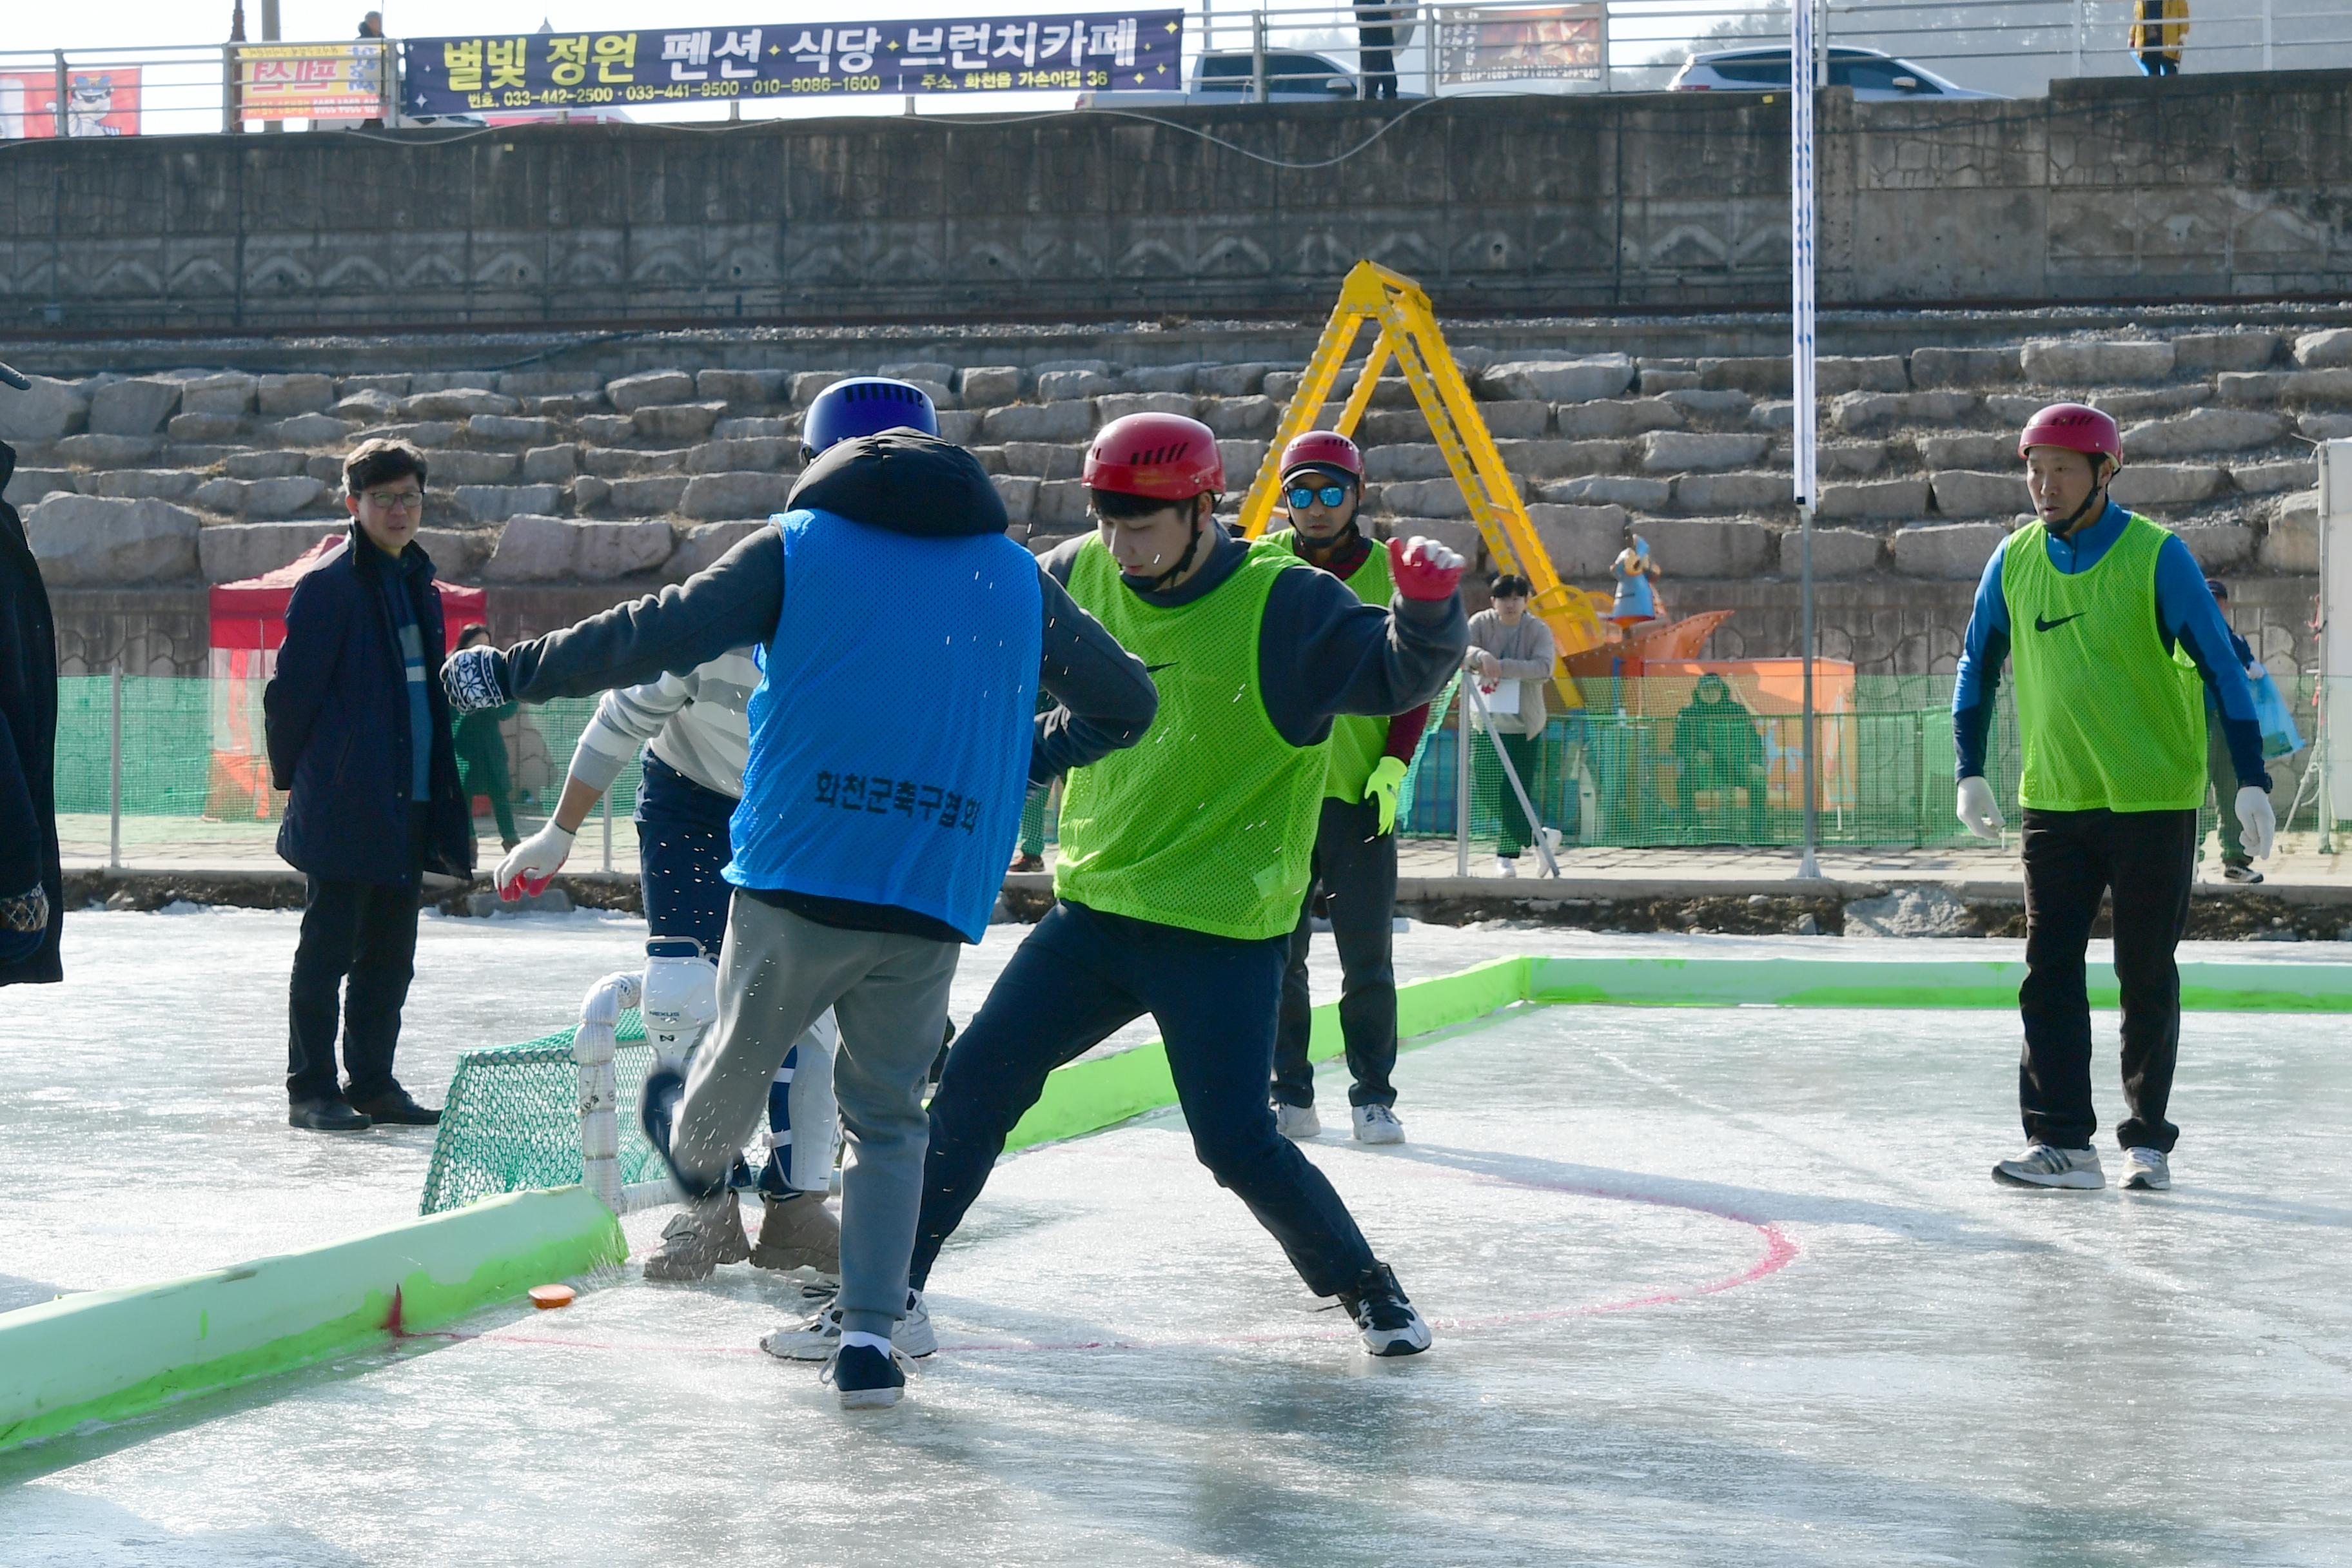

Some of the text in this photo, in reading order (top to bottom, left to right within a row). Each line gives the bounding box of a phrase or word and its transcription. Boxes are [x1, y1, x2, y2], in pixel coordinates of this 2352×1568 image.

[444, 18, 1137, 91] 별빛 정원 펜션 식당 브런치카페
[468, 92, 500, 108] 번호.
[504, 88, 612, 106] 033-442-2500
[626, 80, 740, 101] 033-441-9500
[752, 75, 880, 94] 010-9086-1600
[921, 74, 957, 90] 주소.
[965, 72, 1012, 89] 화천읍
[1087, 71, 1108, 86] 36
[815, 770, 981, 836] 화천군축구협회
